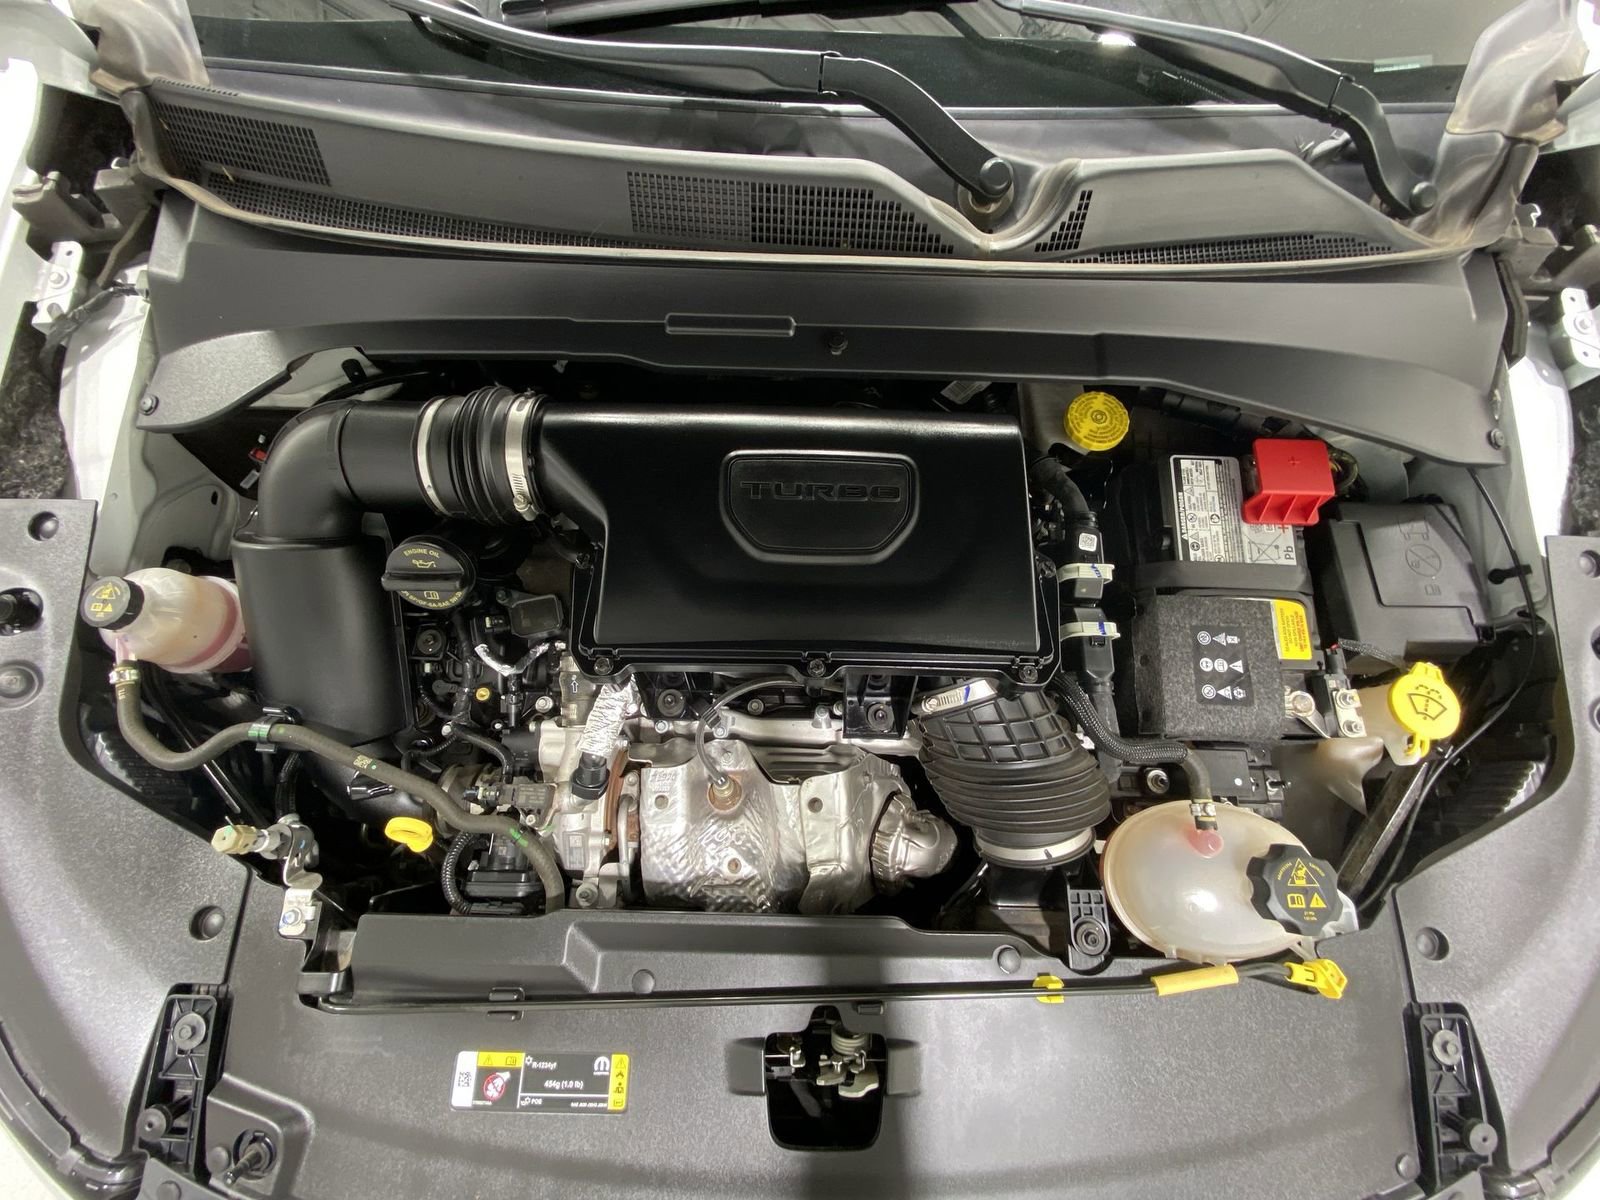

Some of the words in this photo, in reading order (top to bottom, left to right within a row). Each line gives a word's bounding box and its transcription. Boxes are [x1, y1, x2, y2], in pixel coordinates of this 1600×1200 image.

[740, 481, 900, 502] TURBO
[403, 548, 428, 557] ENGINE
[429, 550, 440, 558] OIL
[1283, 545, 1294, 560] Pb
[544, 1080, 560, 1090] 454g
[574, 1081, 584, 1090] lb)
